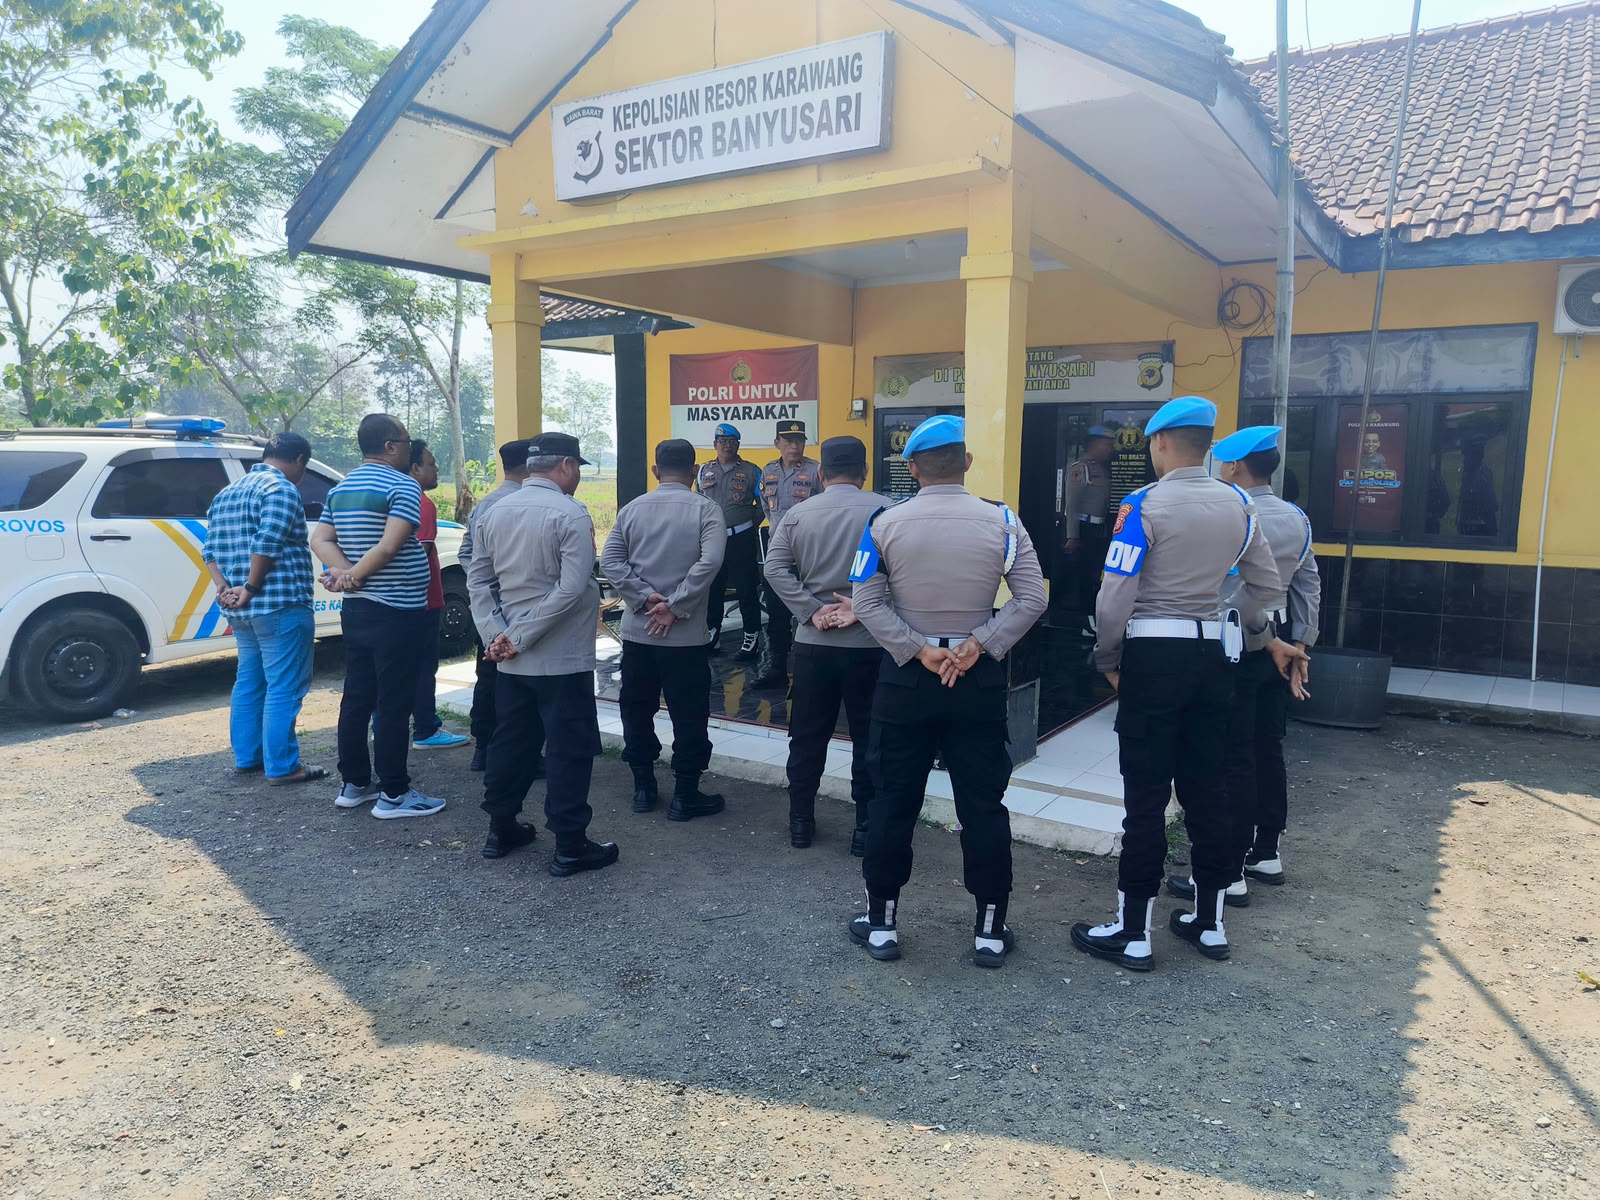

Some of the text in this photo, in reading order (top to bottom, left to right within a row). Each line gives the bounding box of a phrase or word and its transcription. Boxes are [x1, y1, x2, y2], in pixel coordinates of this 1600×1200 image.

[613, 52, 863, 132] KEPOLISIAN RESOR KARAWANG
[566, 109, 602, 124] JAWA BARAT
[615, 92, 862, 175] SEKTOR BANYUSARI
[934, 368, 949, 382] DI
[688, 383, 798, 401] POLRI UNTUK
[1044, 379, 1070, 390] ANDA
[688, 404, 799, 421] MASYARAKAT
[315, 600, 327, 611] ES
